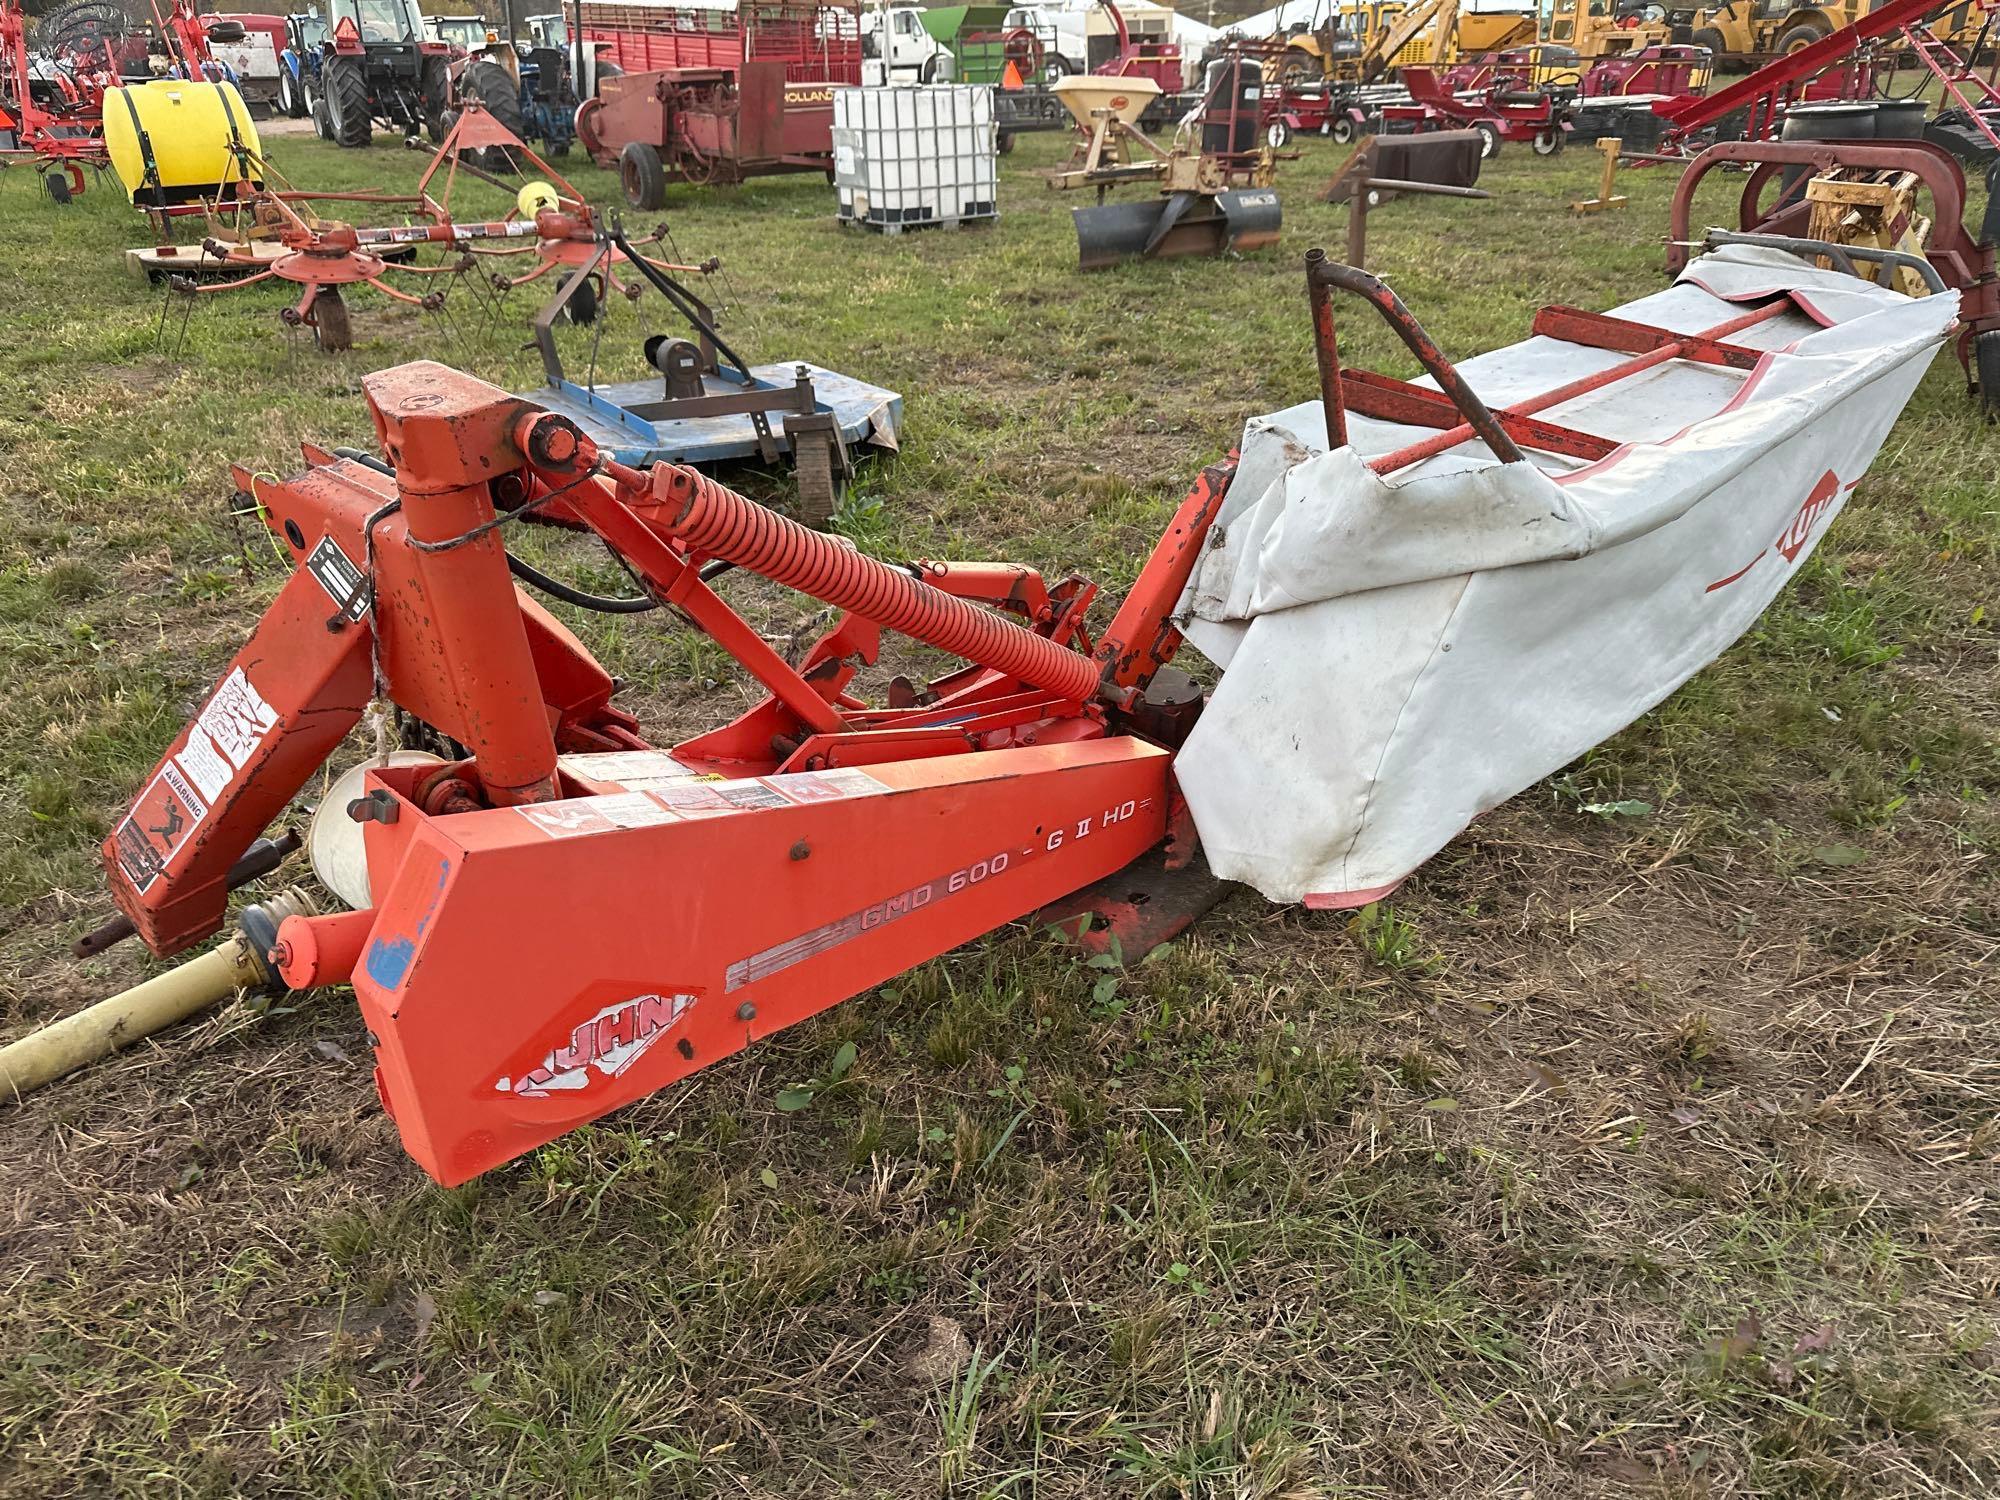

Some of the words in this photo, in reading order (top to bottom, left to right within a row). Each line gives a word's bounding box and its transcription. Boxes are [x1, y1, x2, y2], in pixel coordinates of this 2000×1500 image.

[171, 775, 202, 818] WARNING
[860, 885, 933, 931] GMD
[948, 853, 1008, 894] 600
[1046, 830, 1064, 851] G
[1075, 818, 1092, 839] II
[1102, 800, 1136, 828] HD
